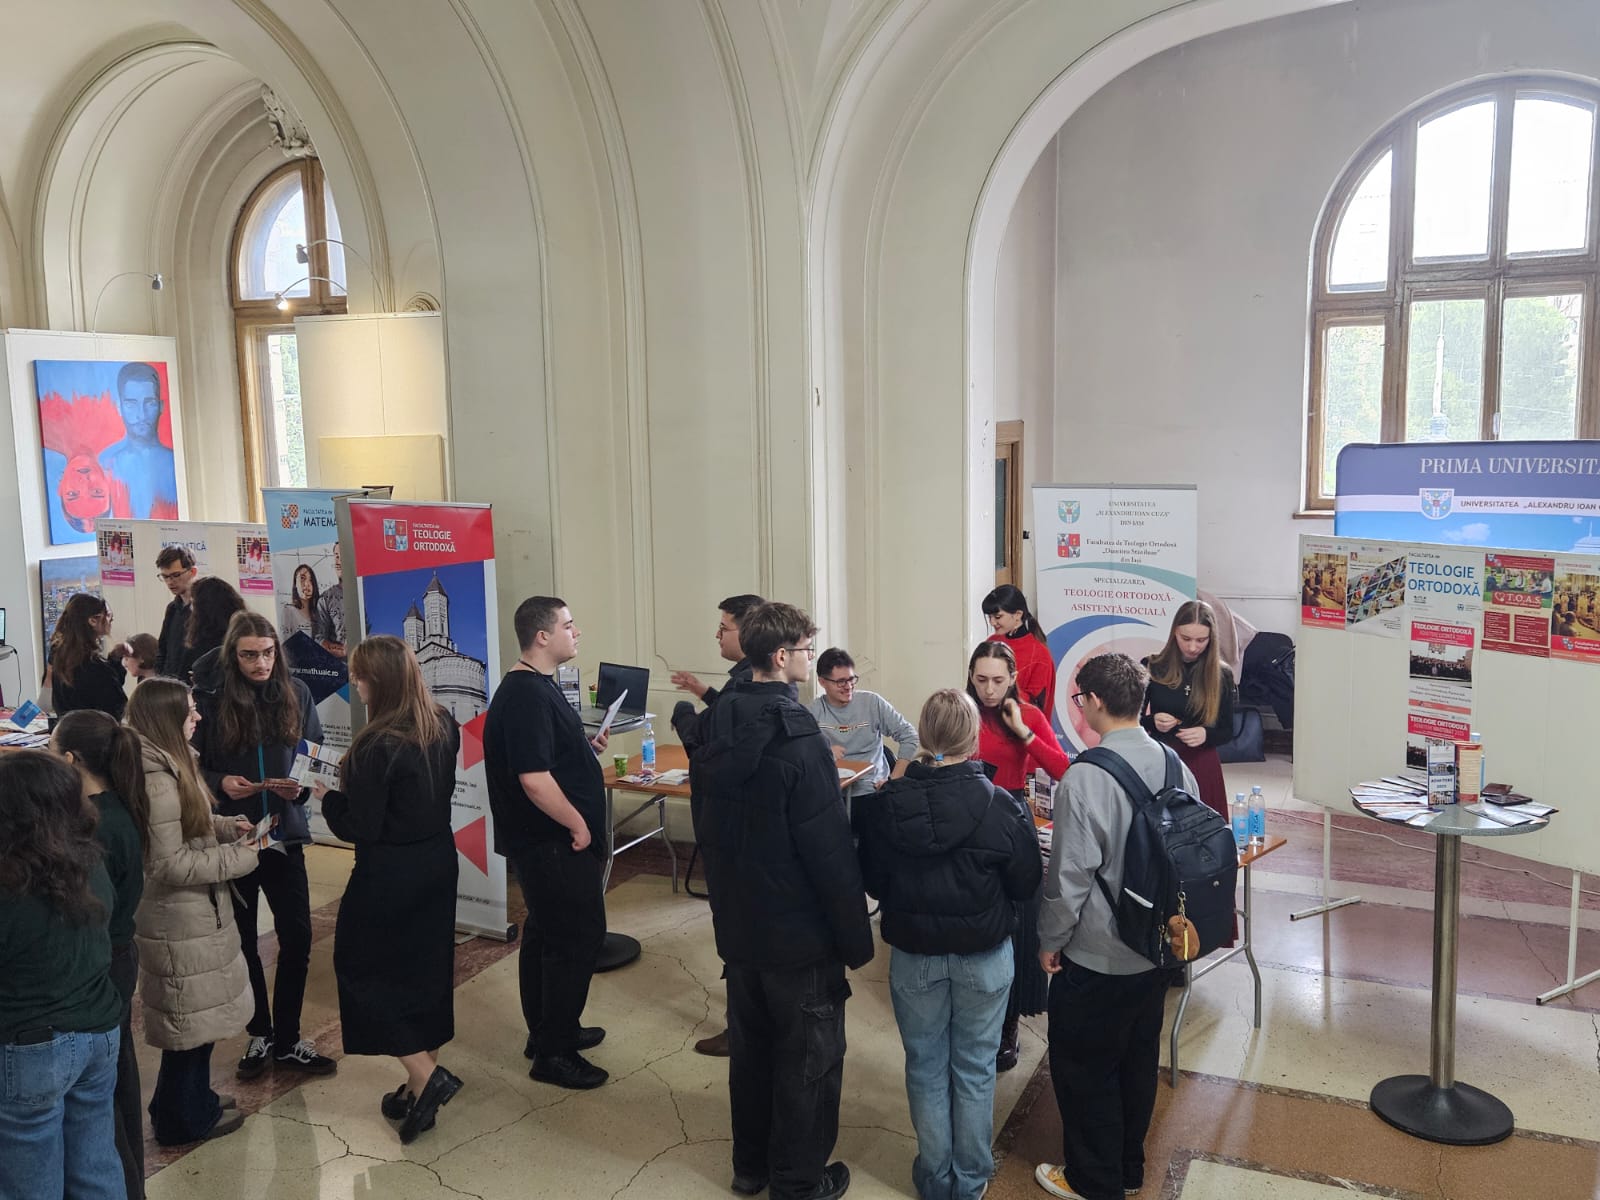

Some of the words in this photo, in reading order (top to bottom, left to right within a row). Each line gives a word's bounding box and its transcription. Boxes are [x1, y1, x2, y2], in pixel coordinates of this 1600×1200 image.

[1419, 458, 1482, 474] PRIMA
[1489, 458, 1600, 475] UNIVERSIT
[304, 517, 337, 527] MATEMA
[413, 530, 452, 540] TEOLOGIE
[414, 541, 456, 553] ORTODOXĂ
[1123, 540, 1148, 548] Teologie
[1409, 562, 1475, 579] TEOLOGIE
[1094, 577, 1146, 586] SPECIALIZAREA
[1408, 579, 1480, 597] ORTODOXĂ
[1064, 589, 1114, 599] TEOLOGIE
[1124, 606, 1167, 616] SOCIALĂ
[1413, 623, 1440, 632] TEOLOGIE
[1440, 626, 1473, 635] ORTODOXĂ
[1410, 715, 1437, 726] TEOLOGIE
[1437, 720, 1468, 731] ORTODOXĂ
